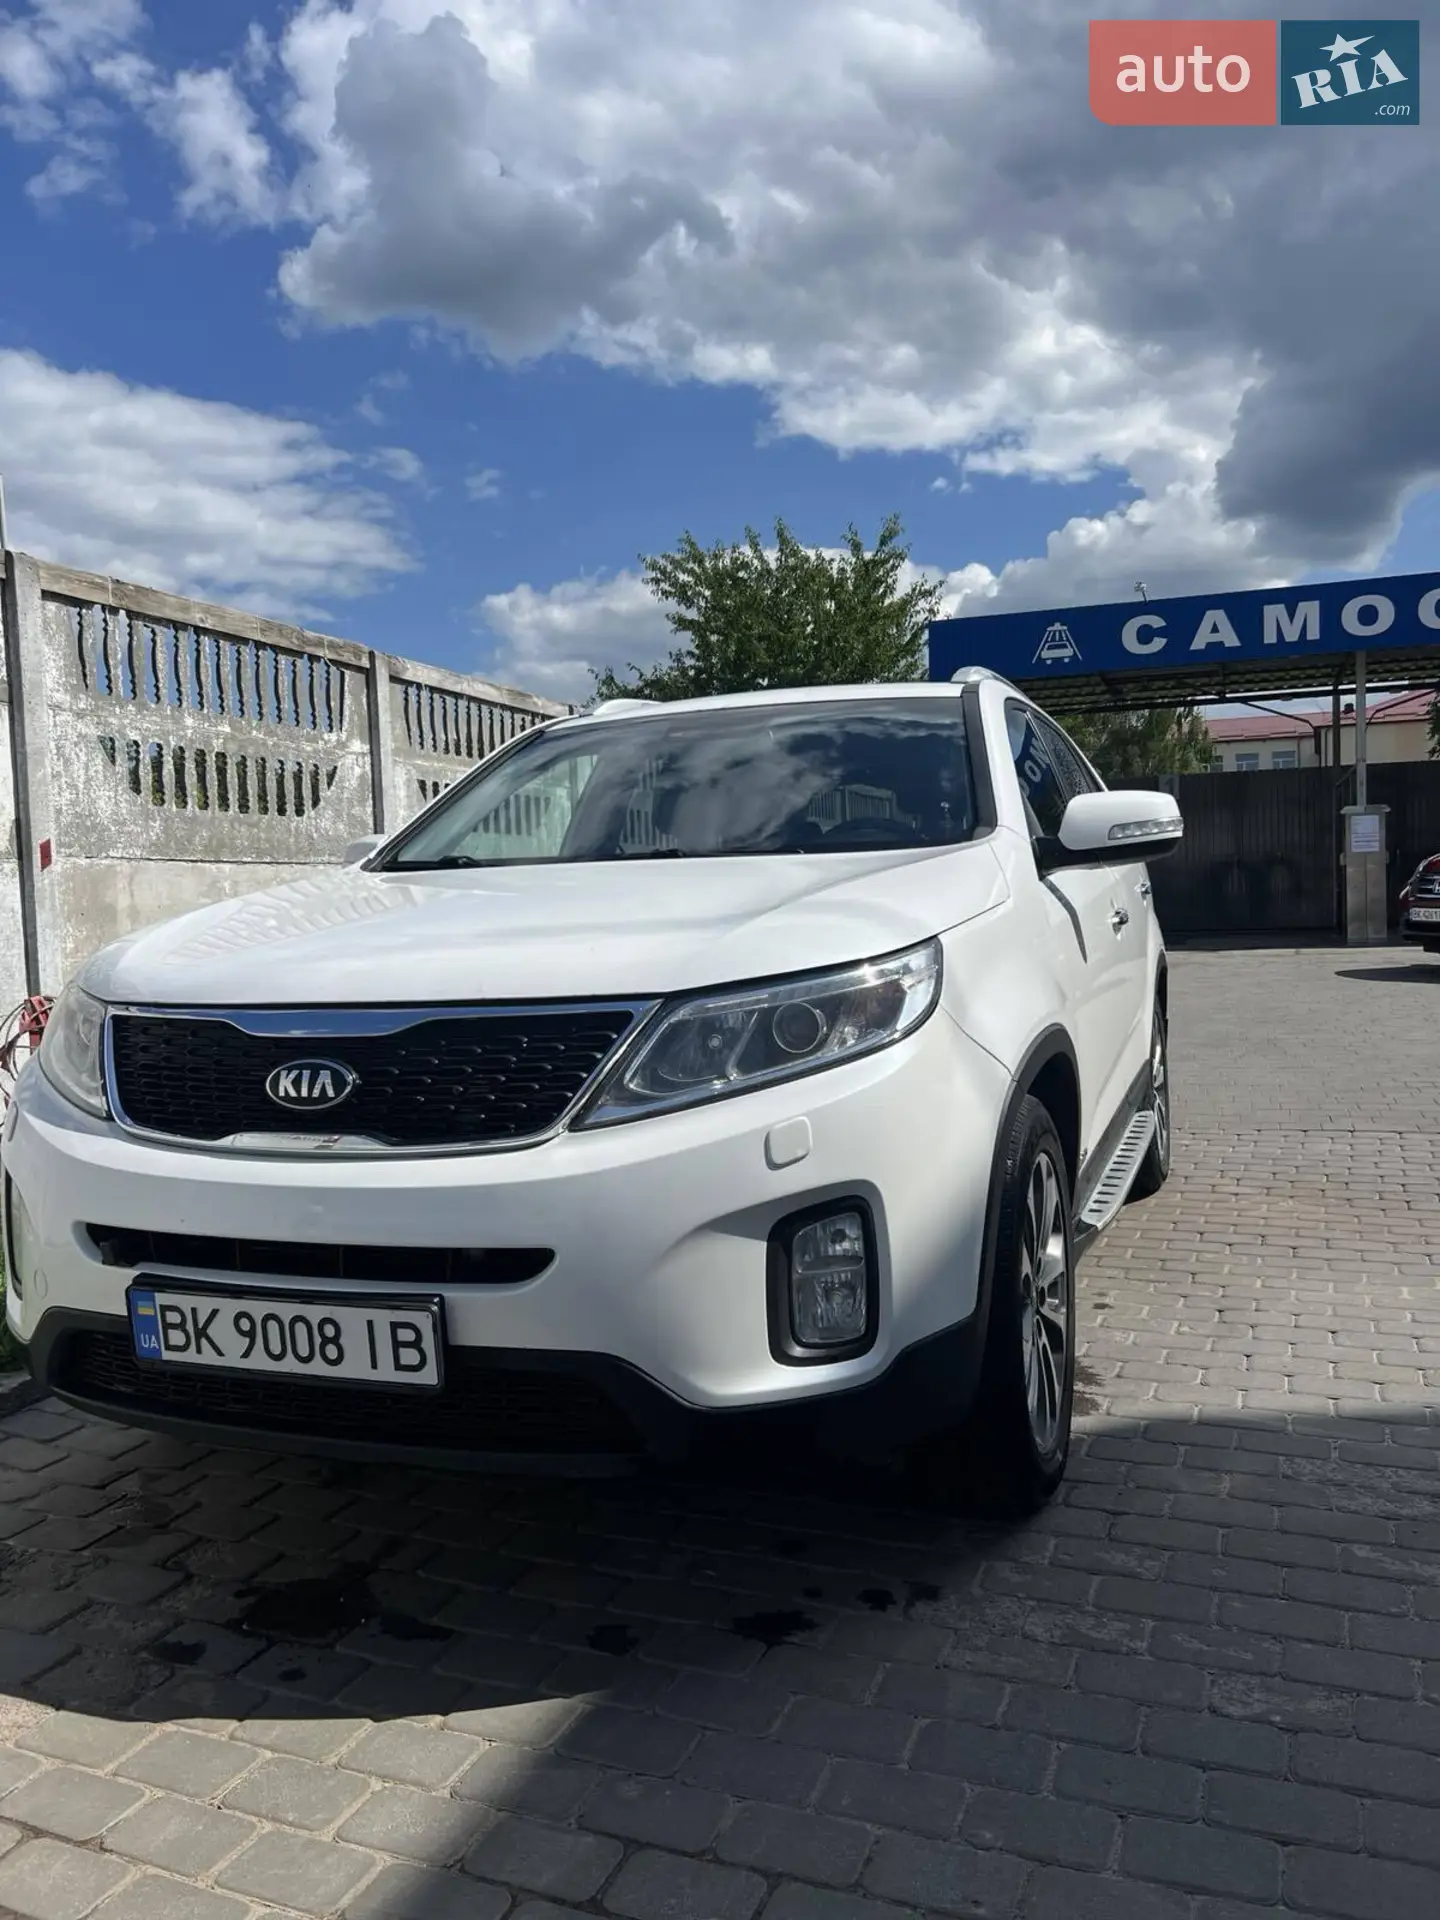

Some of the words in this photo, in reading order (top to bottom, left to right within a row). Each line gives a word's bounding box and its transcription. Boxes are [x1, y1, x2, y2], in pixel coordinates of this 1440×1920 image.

[278, 1070, 336, 1098] KIA
[140, 1332, 160, 1350] UA
[159, 1303, 225, 1357] BK
[232, 1310, 345, 1367] 9008
[366, 1319, 428, 1373] IB
